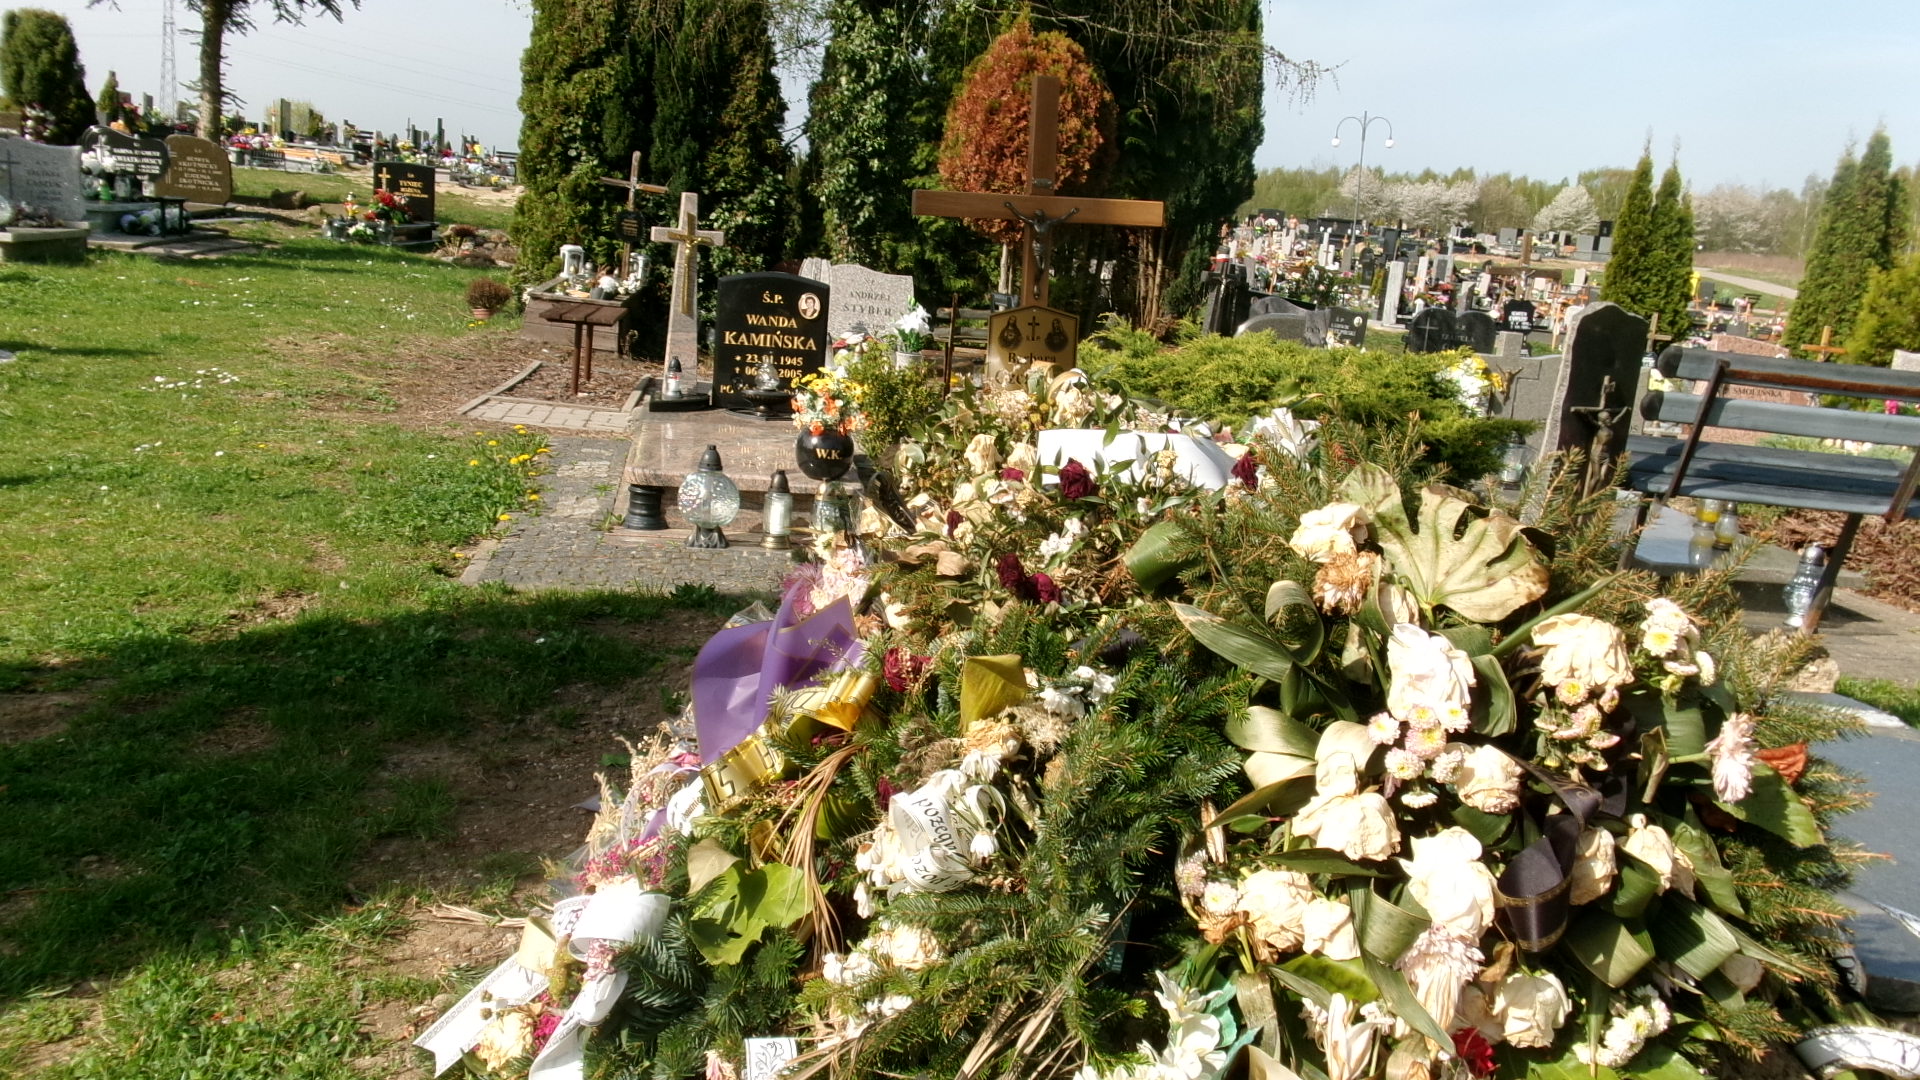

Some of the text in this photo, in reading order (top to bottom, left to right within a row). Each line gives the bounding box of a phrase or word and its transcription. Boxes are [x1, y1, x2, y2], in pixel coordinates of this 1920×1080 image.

[762, 290, 784, 304] Ś.P.
[843, 303, 892, 317] STYBER
[746, 314, 798, 329] WANDA
[724, 330, 817, 351] KAMIŃSKA
